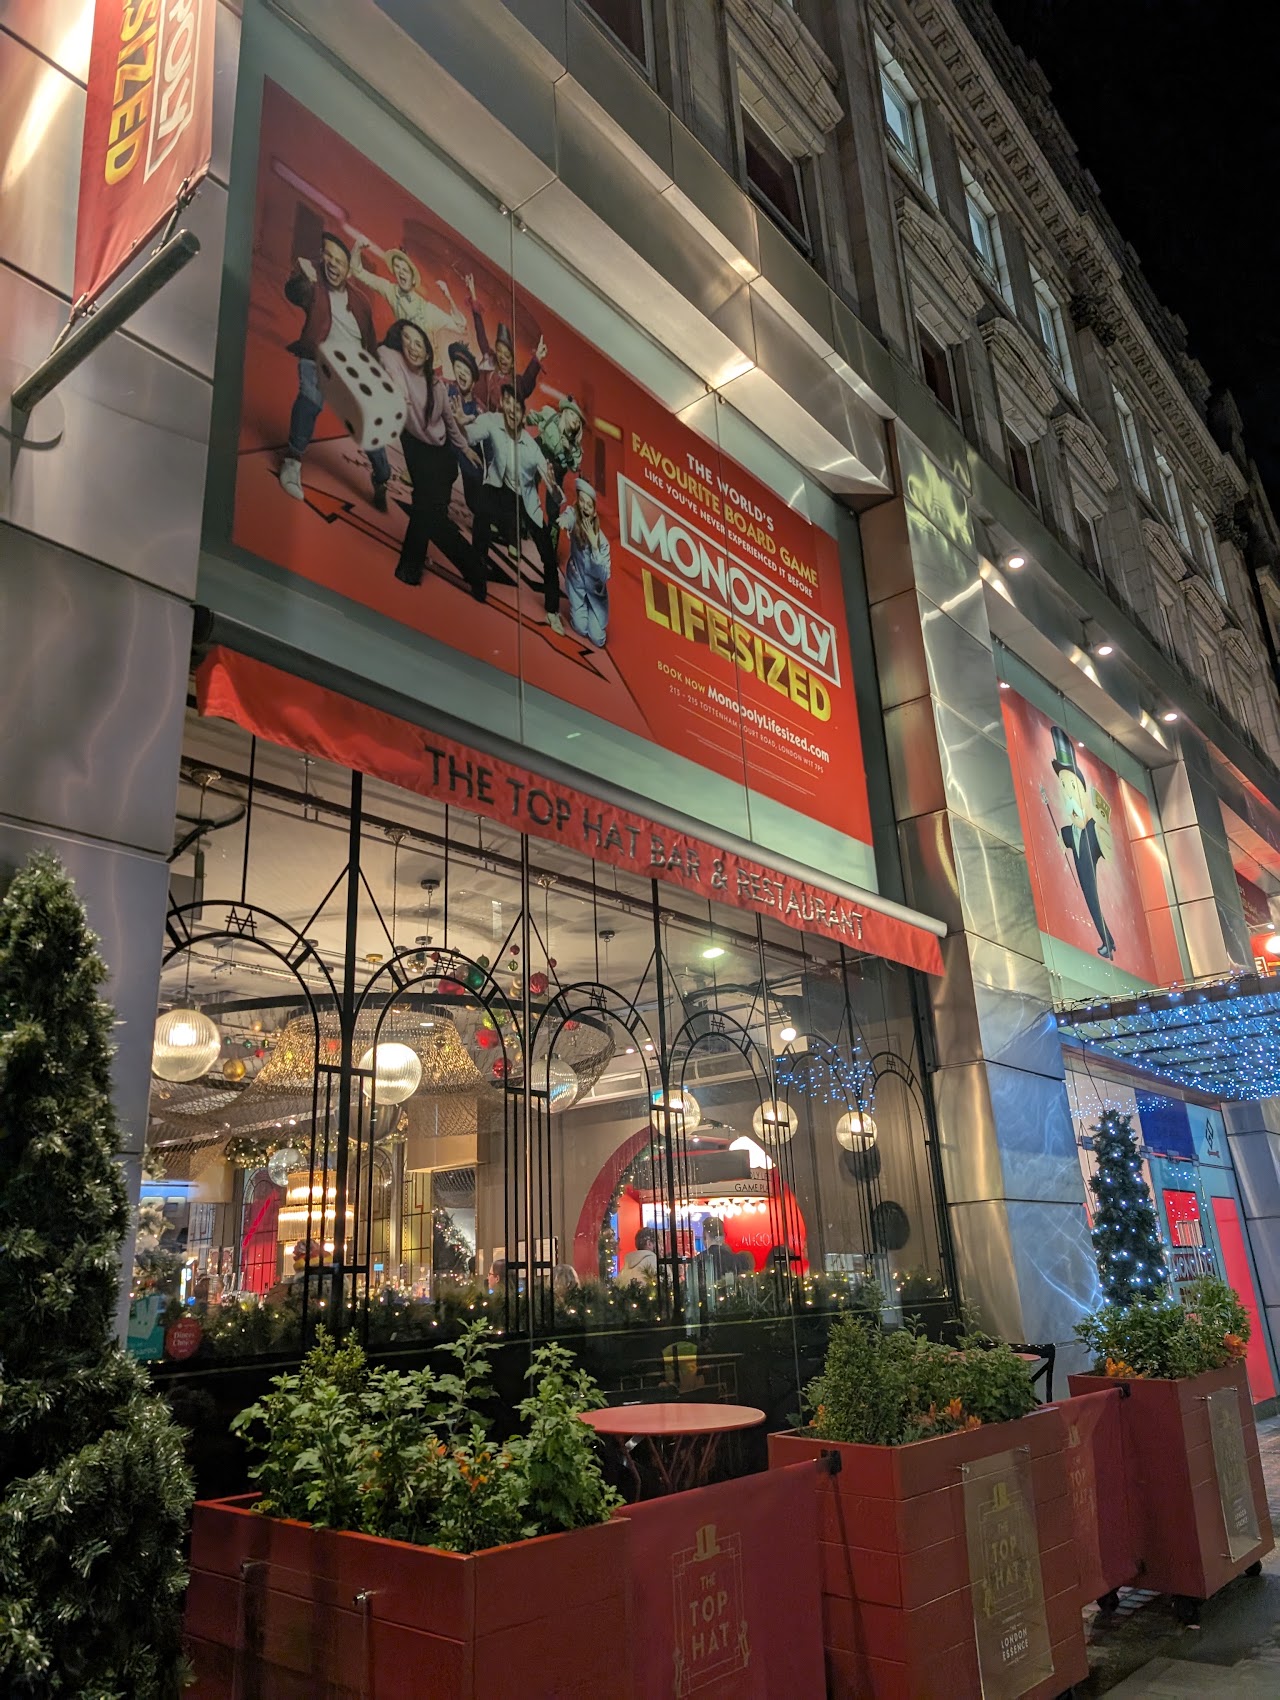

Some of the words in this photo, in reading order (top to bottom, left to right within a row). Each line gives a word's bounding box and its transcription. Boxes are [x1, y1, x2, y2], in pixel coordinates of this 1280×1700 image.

[104, 0, 158, 185] SIZED
[631, 431, 721, 515] FAVOURITE
[724, 502, 777, 555] BOARD
[779, 546, 819, 588] GAME
[686, 452, 713, 485] THE
[716, 476, 775, 532] WORLD'S
[643, 467, 664, 489] LIKE
[665, 483, 699, 515] YOU'VE
[700, 508, 726, 535] NEVER
[727, 529, 778, 572] EXPERIENCED
[779, 566, 786, 578] IT
[787, 573, 814, 599] BEFORE
[630, 492, 831, 667] MONOPOLY
[641, 568, 832, 722] LIFESIZED
[657, 660, 683, 682] BOOK
[684, 676, 706, 694] NOW
[707, 684, 831, 764] MonopolyLifesized.com
[699, 701, 738, 728] TOTTENHAM
[760, 733, 778, 750] ROAD,
[778, 743, 803, 762] LONDON
[424, 744, 494, 806] THE
[506, 777, 571, 832] TOP
[582, 807, 641, 860] HAT
[650, 832, 701, 884] BAR
[710, 858, 729, 892] &
[736, 867, 864, 941] RESTAURANT
[734, 1183, 758, 1193] GAME
[991, 1535, 1017, 1564] TOP
[994, 1559, 1019, 1592] HAT
[689, 1590, 728, 1627] TOP
[700, 1571, 716, 1590] THE
[691, 1621, 730, 1662] HAT
[1000, 1626, 1028, 1650] LONDON
[1002, 1638, 1029, 1662] ESSENCE
